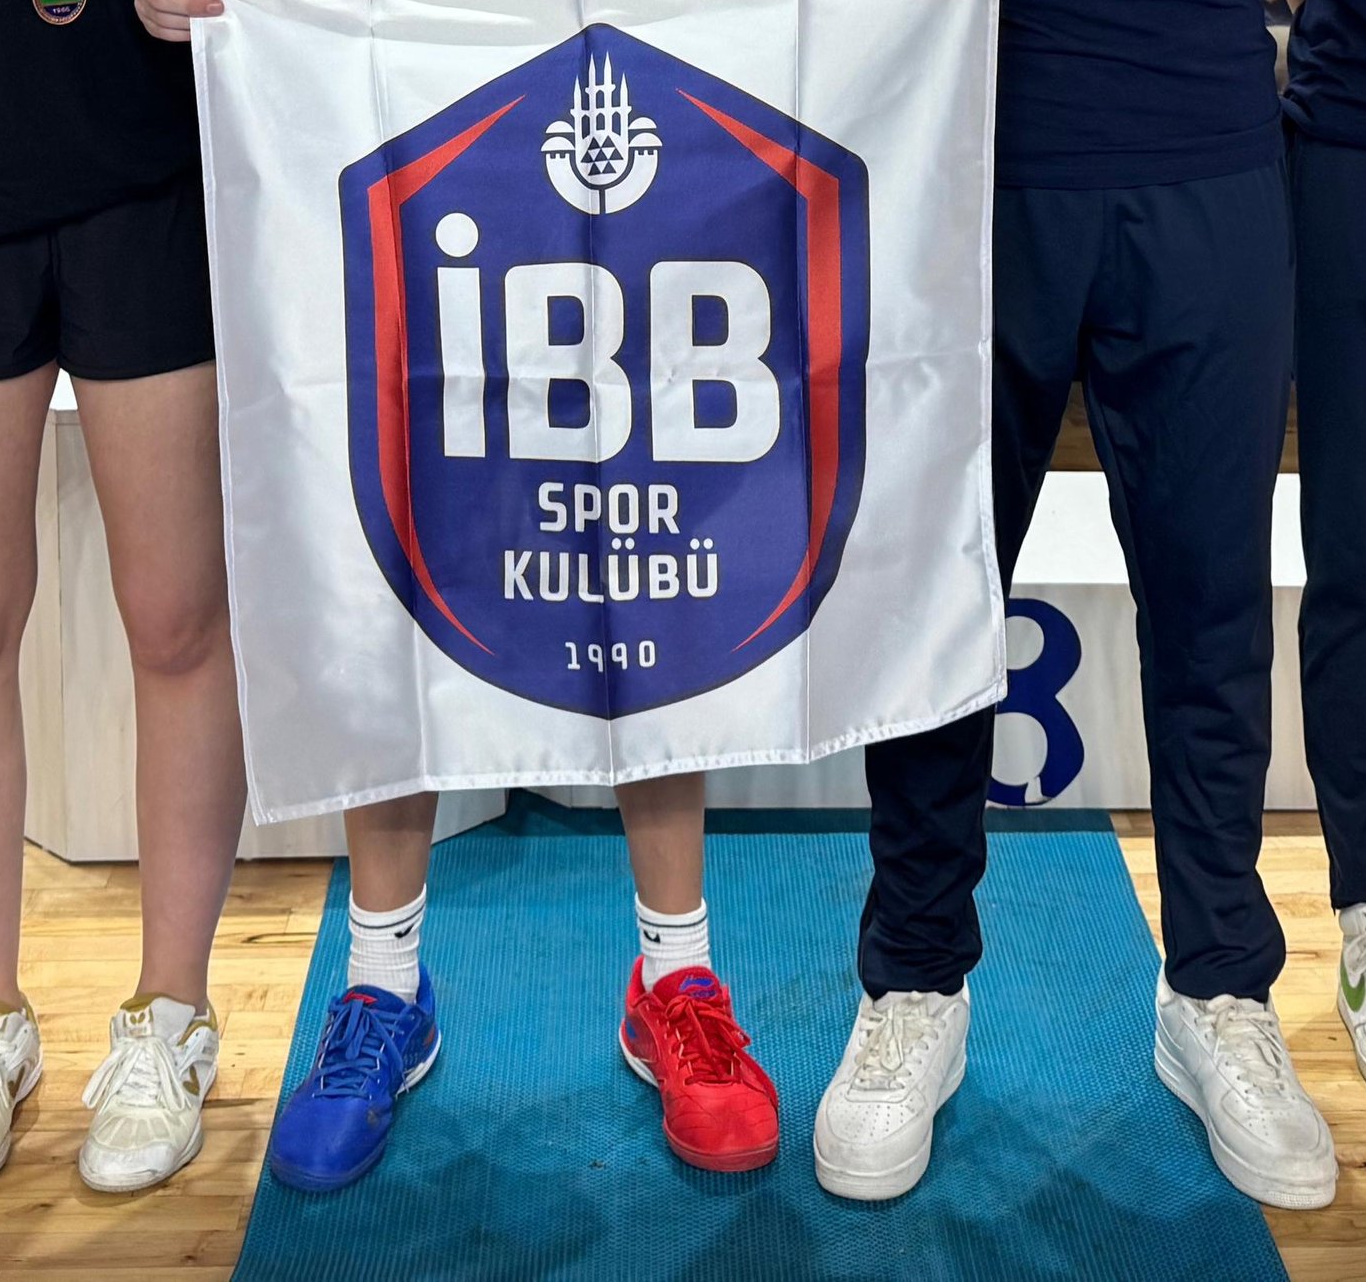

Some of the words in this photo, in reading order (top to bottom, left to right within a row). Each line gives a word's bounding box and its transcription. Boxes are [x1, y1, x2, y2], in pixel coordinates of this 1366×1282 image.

[434, 212, 783, 462] İBB
[537, 480, 681, 537] SPOR
[502, 537, 719, 604] KULÜBÜ
[564, 638, 657, 673] 1990
